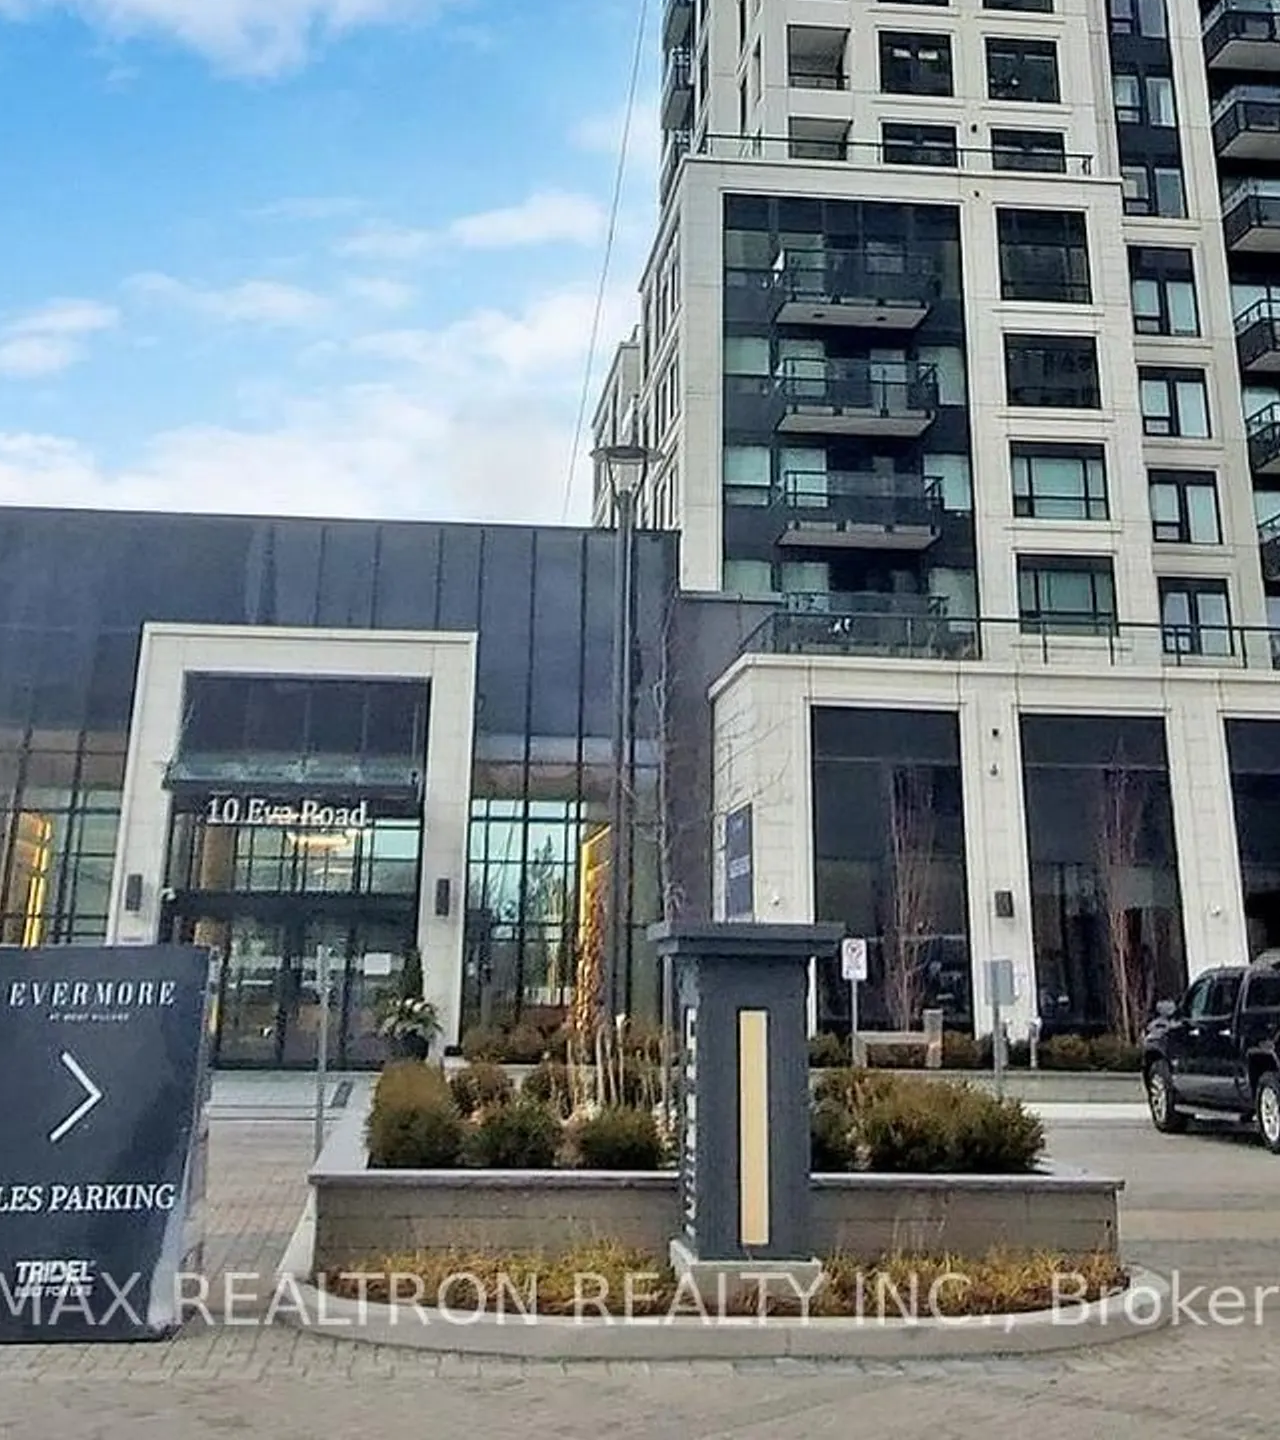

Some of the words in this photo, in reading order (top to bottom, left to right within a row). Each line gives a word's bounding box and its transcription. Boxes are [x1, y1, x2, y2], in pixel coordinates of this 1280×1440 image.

[206, 797, 239, 824] 10
[246, 798, 293, 825] Eva
[301, 799, 368, 827] Road
[8, 980, 177, 1007] EVERMORE
[47, 1183, 177, 1212] PARKING
[15, 1260, 95, 1284] TRIDEL
